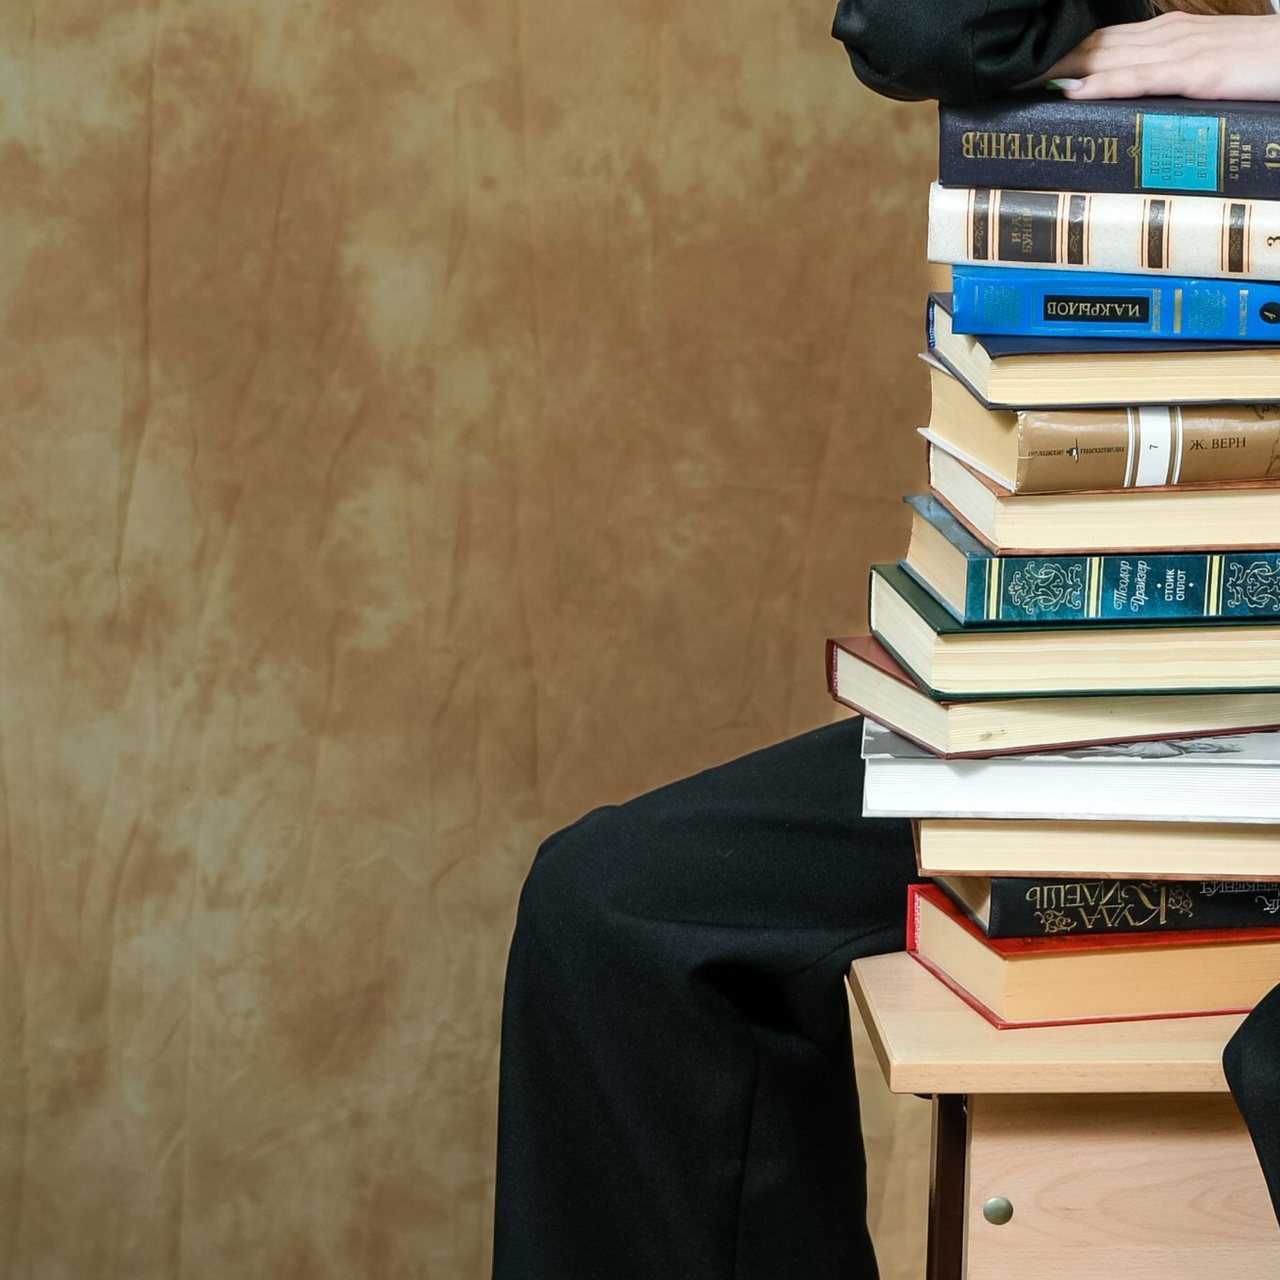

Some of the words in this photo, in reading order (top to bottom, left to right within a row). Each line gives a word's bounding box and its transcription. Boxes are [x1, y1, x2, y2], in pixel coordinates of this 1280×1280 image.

[1189, 439, 1208, 451] Ж.
[1211, 436, 1247, 450] ВЕРН
[1164, 568, 1175, 602] СТОИК
[1175, 569, 1187, 601] ОПЛОТ
